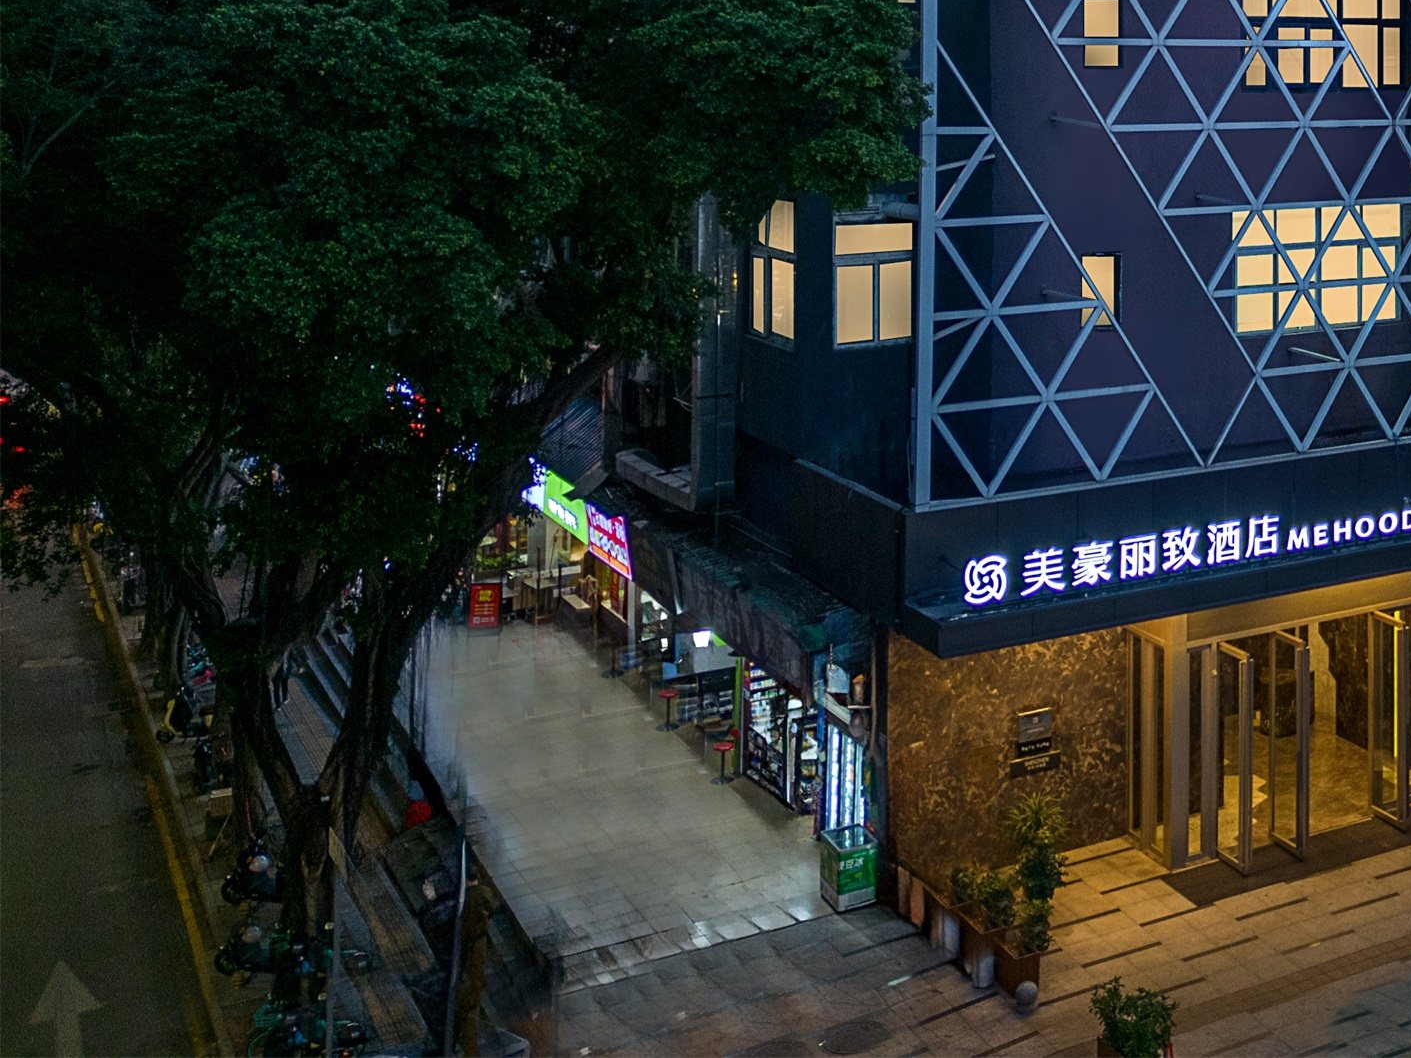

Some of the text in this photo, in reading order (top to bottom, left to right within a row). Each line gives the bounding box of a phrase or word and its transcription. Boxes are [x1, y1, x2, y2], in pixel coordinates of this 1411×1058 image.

[1020, 515, 1281, 596] 美豪丽致酒店
